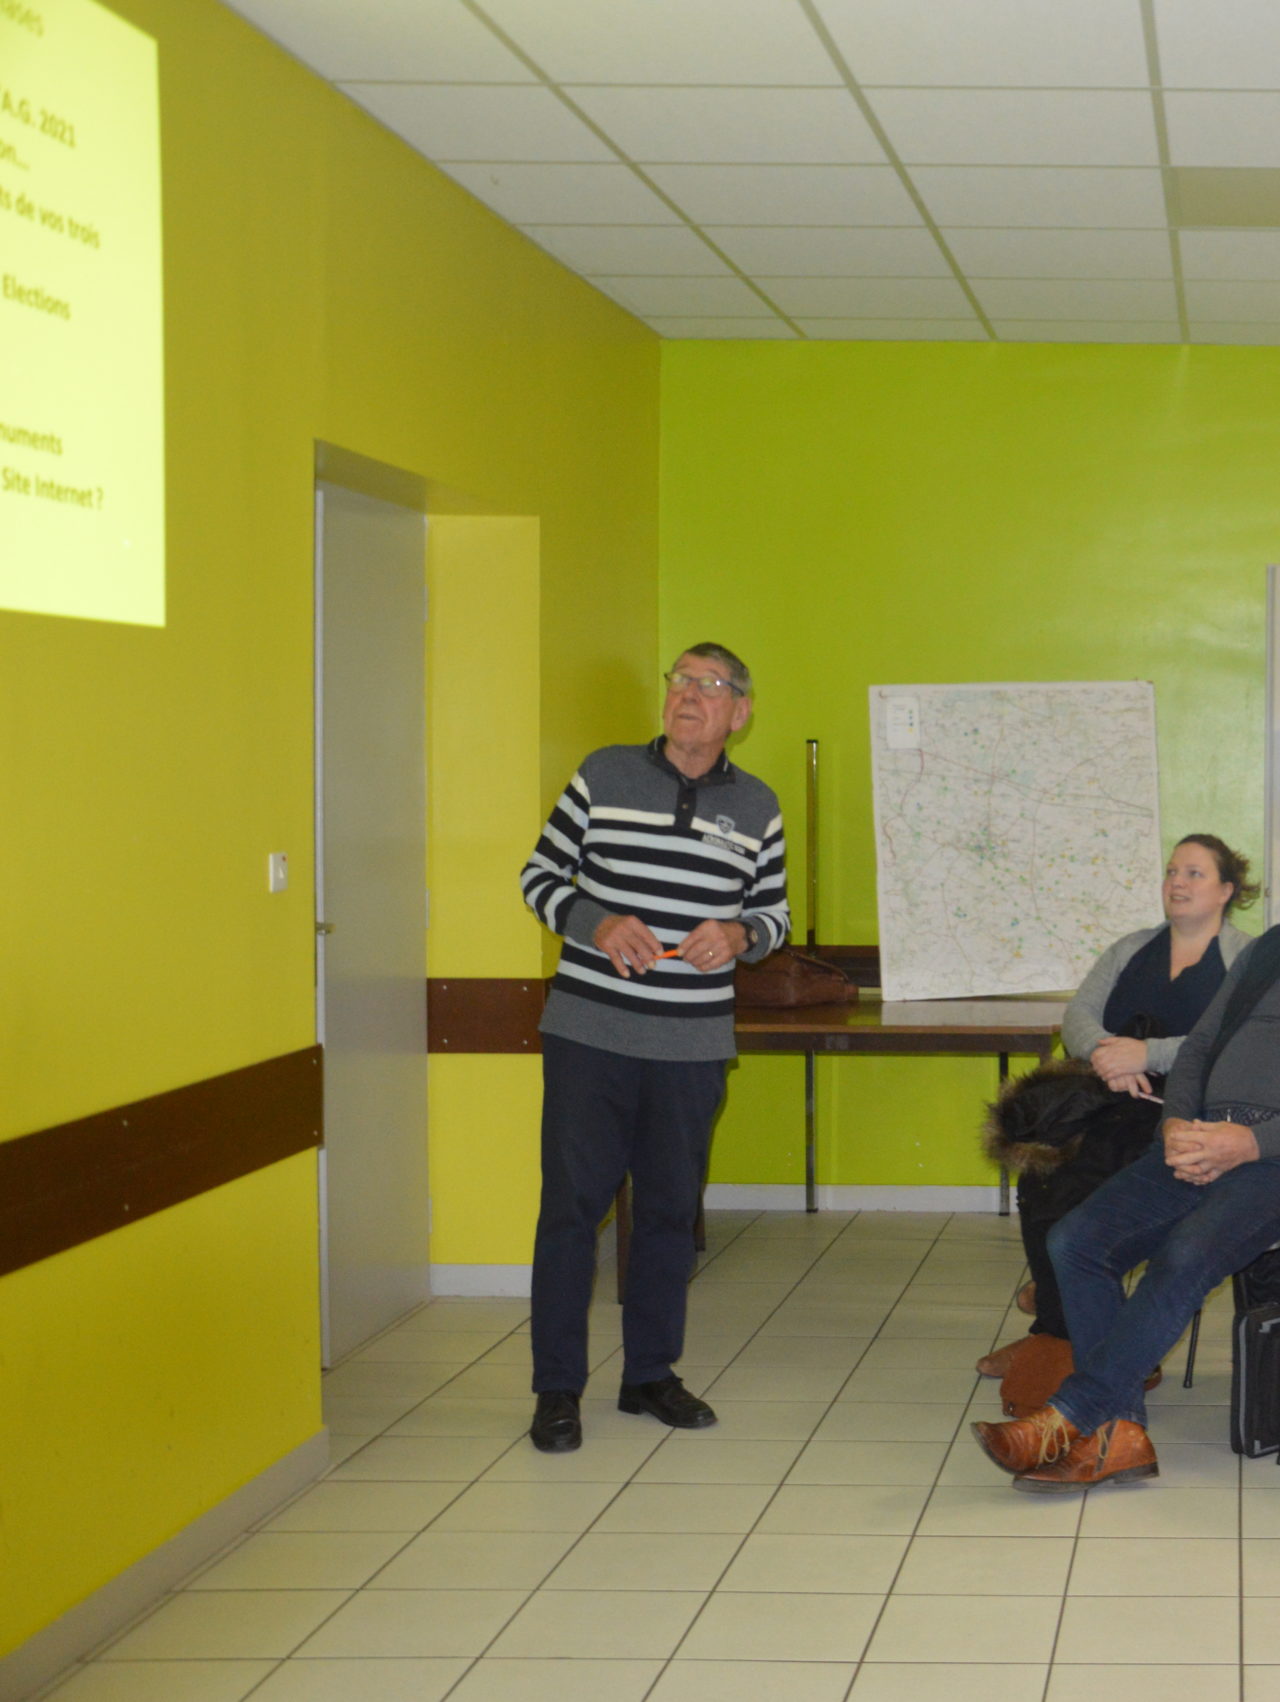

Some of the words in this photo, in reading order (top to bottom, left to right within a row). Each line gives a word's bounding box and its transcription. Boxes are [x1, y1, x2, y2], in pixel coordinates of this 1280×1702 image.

[15, 192, 35, 221] de
[39, 207, 64, 233] vos
[67, 216, 101, 249] trois
[2, 272, 71, 320] Elections
[2, 466, 32, 496] Site
[35, 473, 93, 509] Internet
[96, 487, 104, 510] ?
